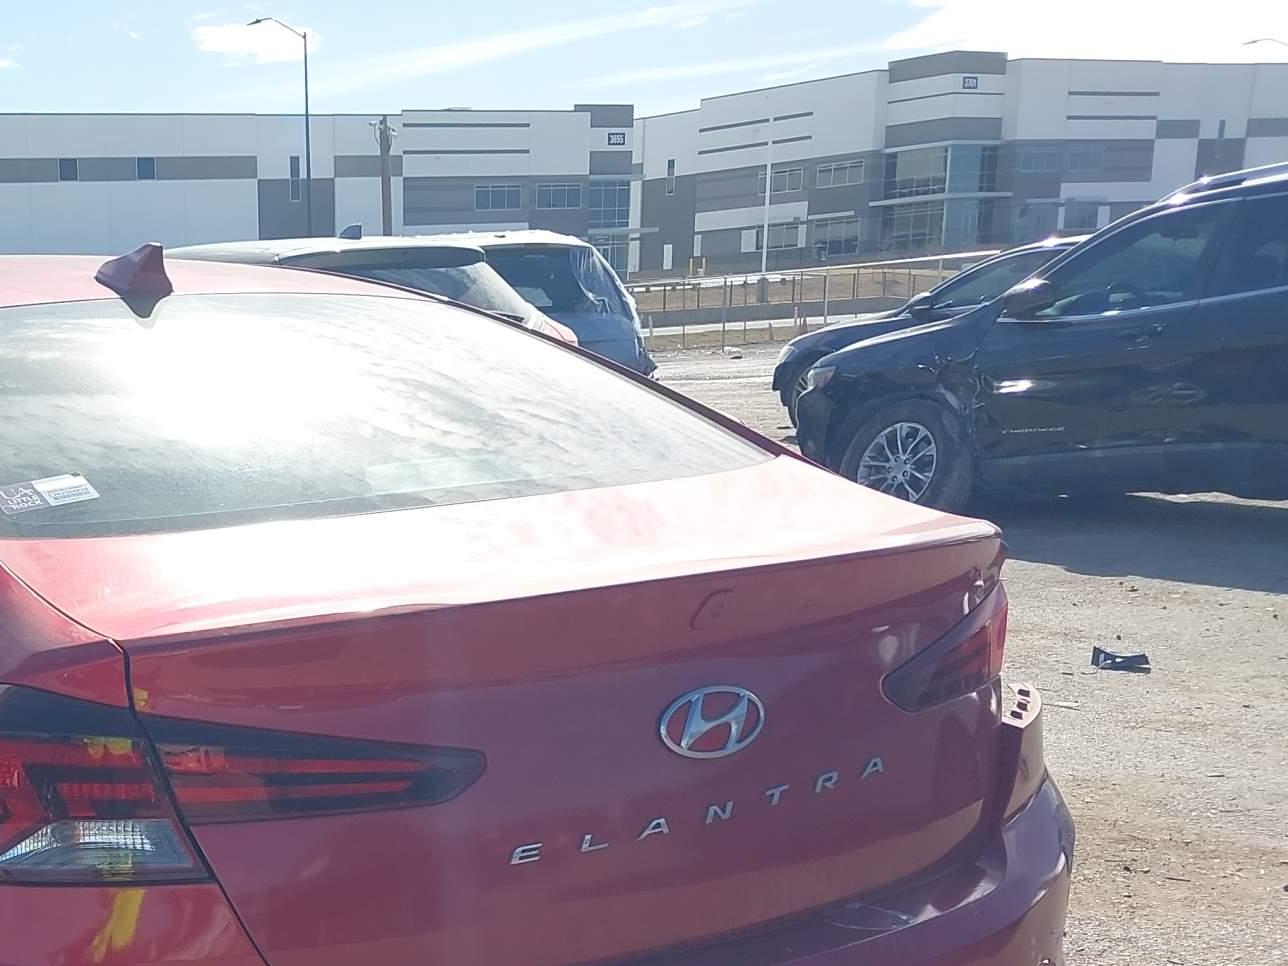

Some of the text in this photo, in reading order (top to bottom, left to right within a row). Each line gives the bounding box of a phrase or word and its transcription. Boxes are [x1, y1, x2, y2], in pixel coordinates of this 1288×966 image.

[7, 494, 42, 505] LITTLE
[10, 499, 45, 510] ROCK
[510, 756, 885, 865] ELANTRA
